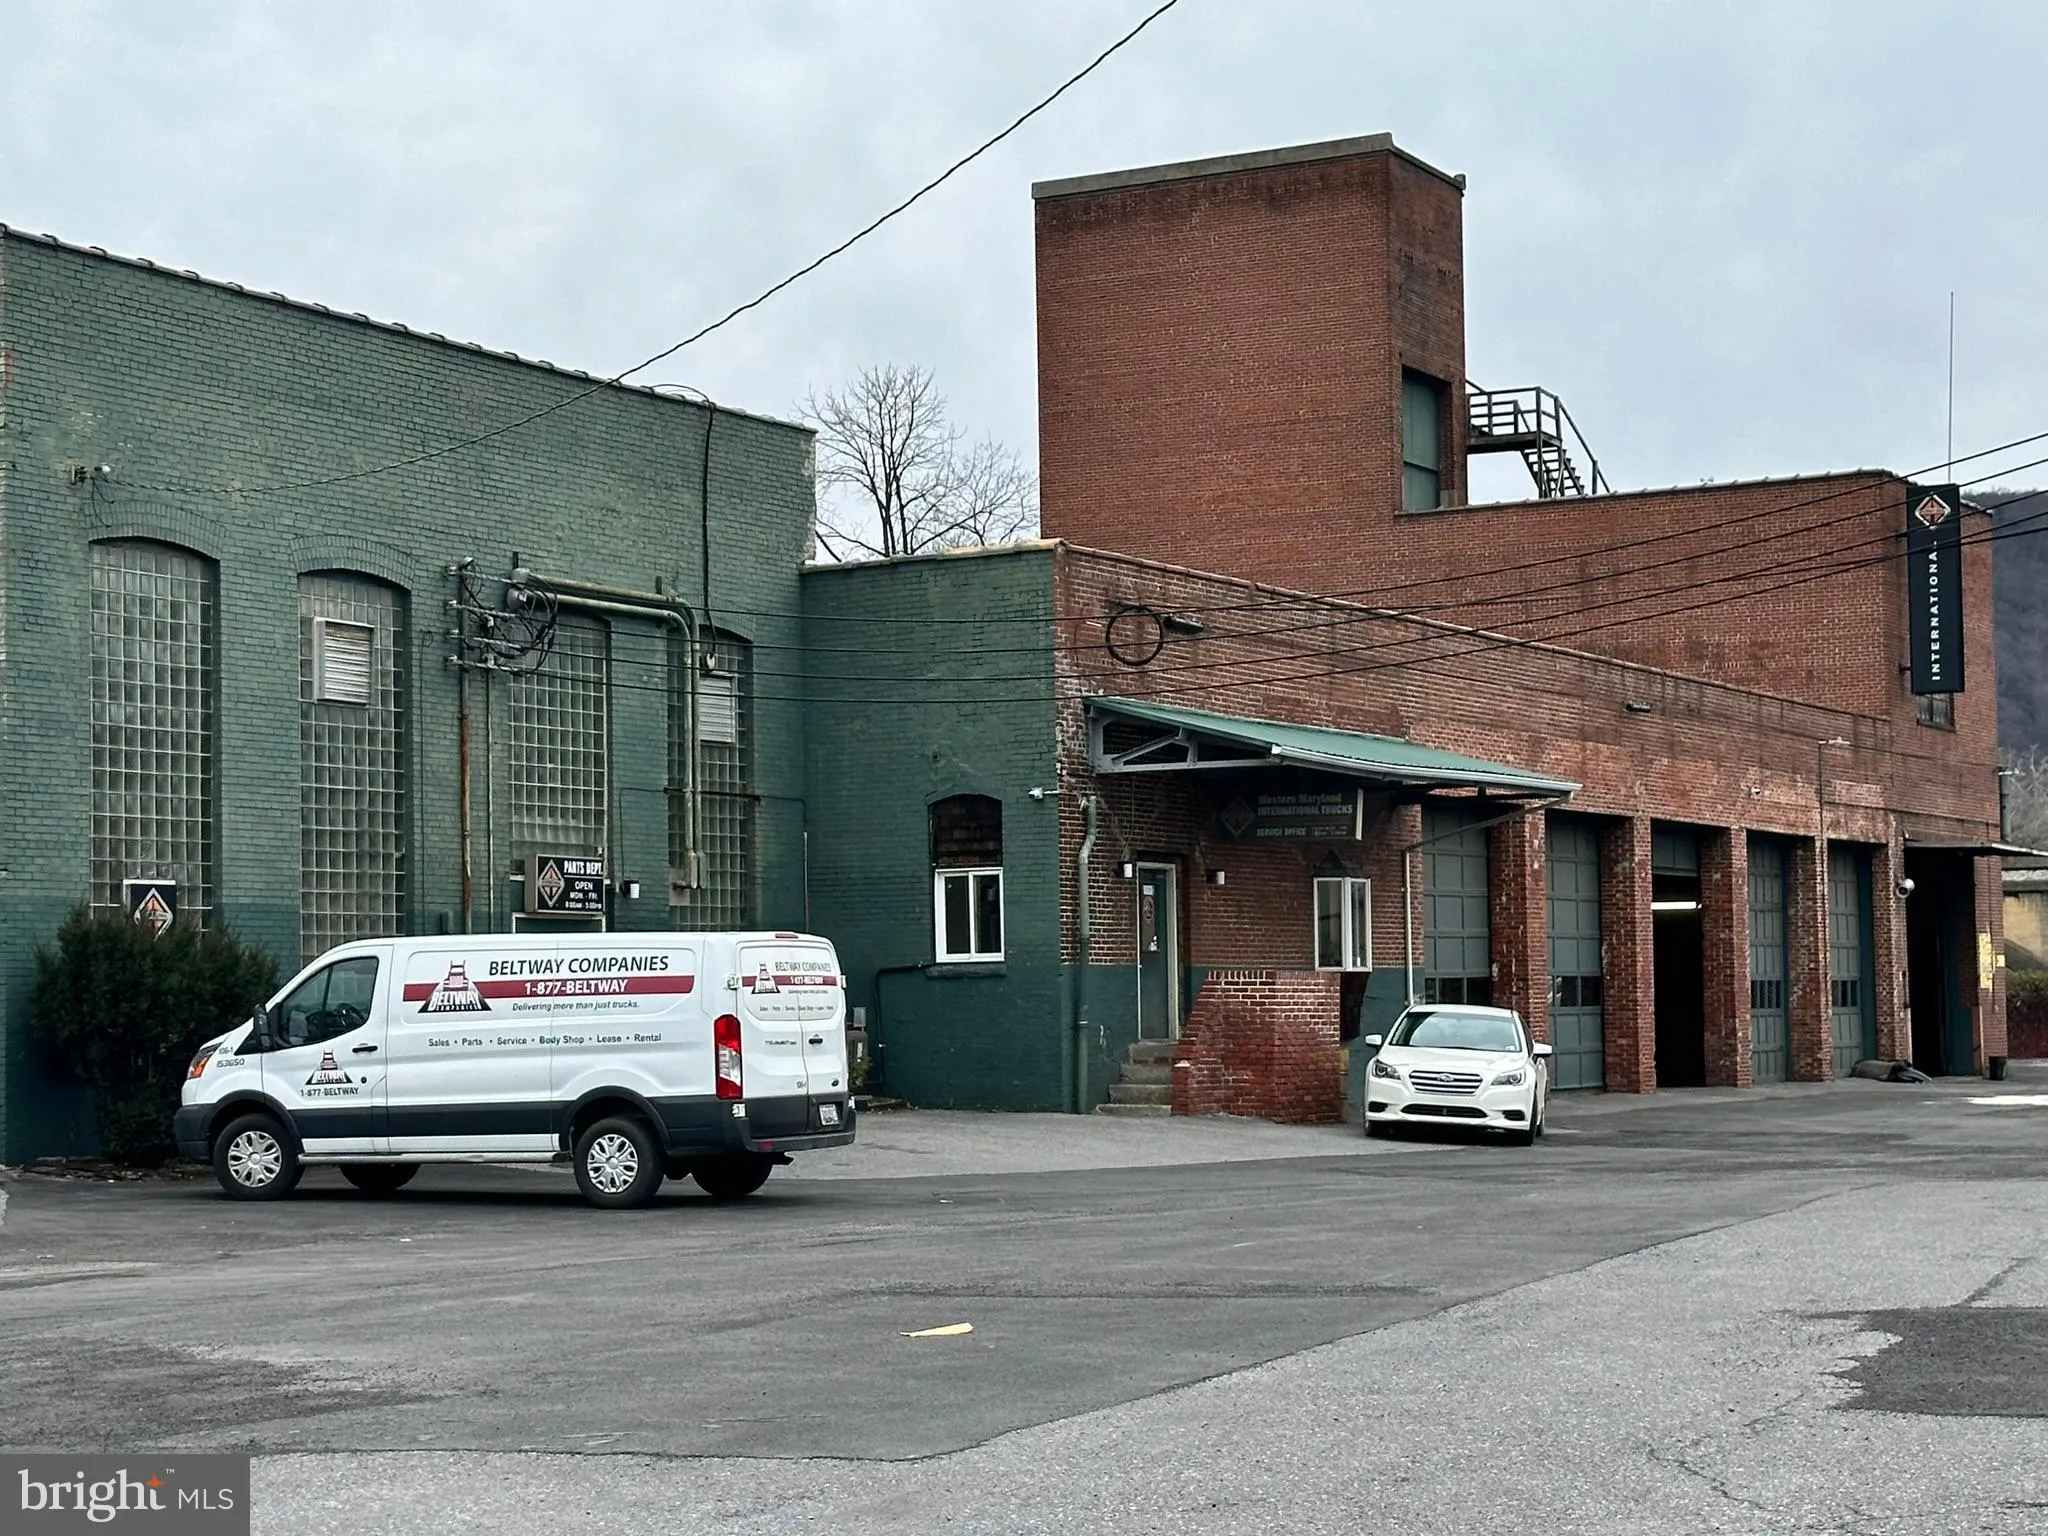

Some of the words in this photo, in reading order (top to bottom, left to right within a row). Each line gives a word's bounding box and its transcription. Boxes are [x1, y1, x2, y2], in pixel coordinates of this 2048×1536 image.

[1258, 806, 1320, 815] INTERNATIONAL
[1321, 804, 1353, 814] TRUCKS
[564, 861, 585, 874] PARTS
[575, 881, 593, 890] OPEN
[489, 958, 564, 977] BELTWAY
[568, 955, 669, 974] COMPANIES
[524, 978, 629, 996] 1-877-BELTWAY
[427, 990, 482, 1012] BELTWAY
[512, 1002, 552, 1012] Delivering
[575, 1001, 593, 1010] than
[593, 1001, 611, 1011] just
[428, 1038, 450, 1048] Sales
[461, 1037, 483, 1046] Parts
[497, 1036, 528, 1046] Service
[539, 1035, 561, 1046] Body
[563, 1035, 585, 1045] Shop
[596, 1034, 622, 1044] Lease
[634, 1033, 662, 1043] Rental
